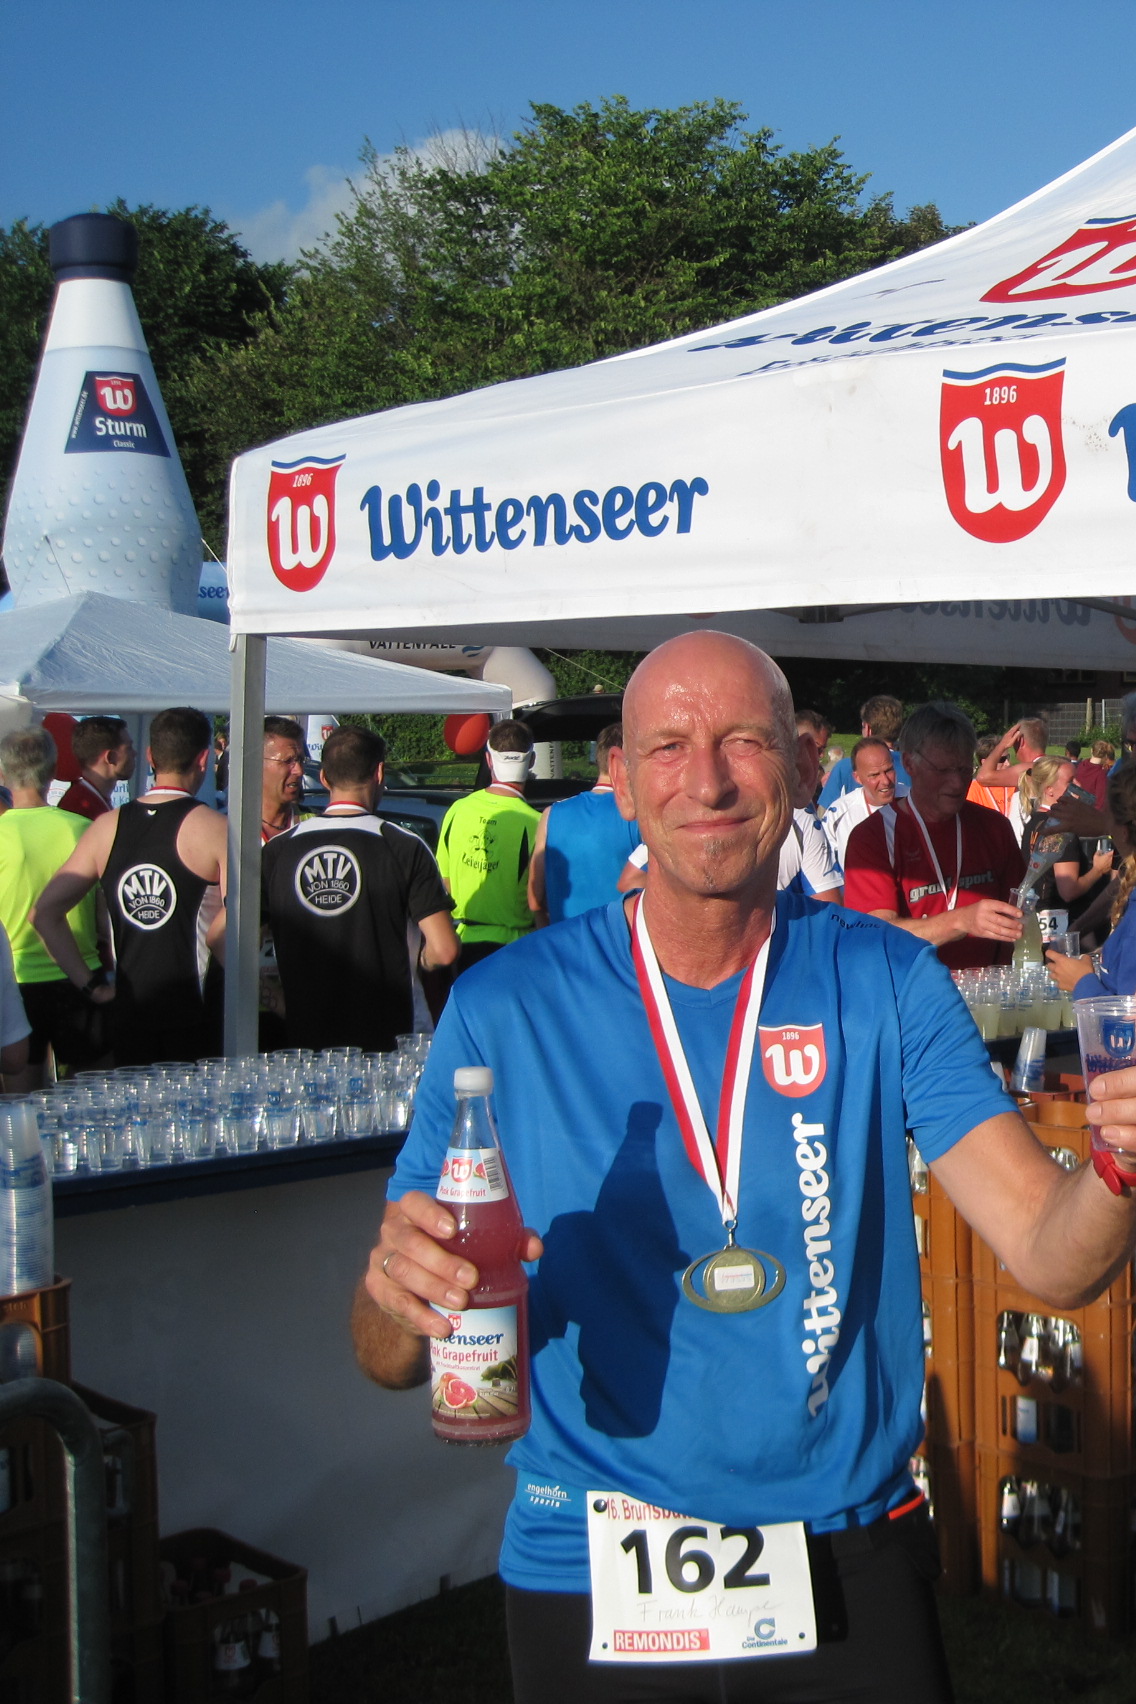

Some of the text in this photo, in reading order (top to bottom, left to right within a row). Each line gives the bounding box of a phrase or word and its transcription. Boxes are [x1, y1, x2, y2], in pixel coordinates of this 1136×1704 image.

[983, 386, 1018, 405] 1896
[95, 417, 147, 438] Sturm
[113, 440, 135, 449] Classic
[291, 473, 313, 488] 1896
[359, 477, 709, 562] Wittenseer
[479, 816, 498, 826] Team
[304, 852, 352, 883] MTV
[124, 870, 167, 900] MTV
[306, 880, 350, 893] VON 1860
[129, 896, 165, 909] VON 1860
[315, 894, 343, 904] HEIDE
[138, 910, 160, 920] HEIDE
[782, 1032, 800, 1040] 1896
[790, 1112, 842, 1419] Wittenseer
[442, 1346, 498, 1363] Grapefruit
[527, 1483, 567, 1499] engelhorn
[606, 1498, 620, 1519] 16.
[620, 1525, 771, 1594] 162
[637, 1597, 703, 1622] Frank
[616, 1630, 701, 1650] REMONDIS
[741, 1637, 788, 1649] Continentale
